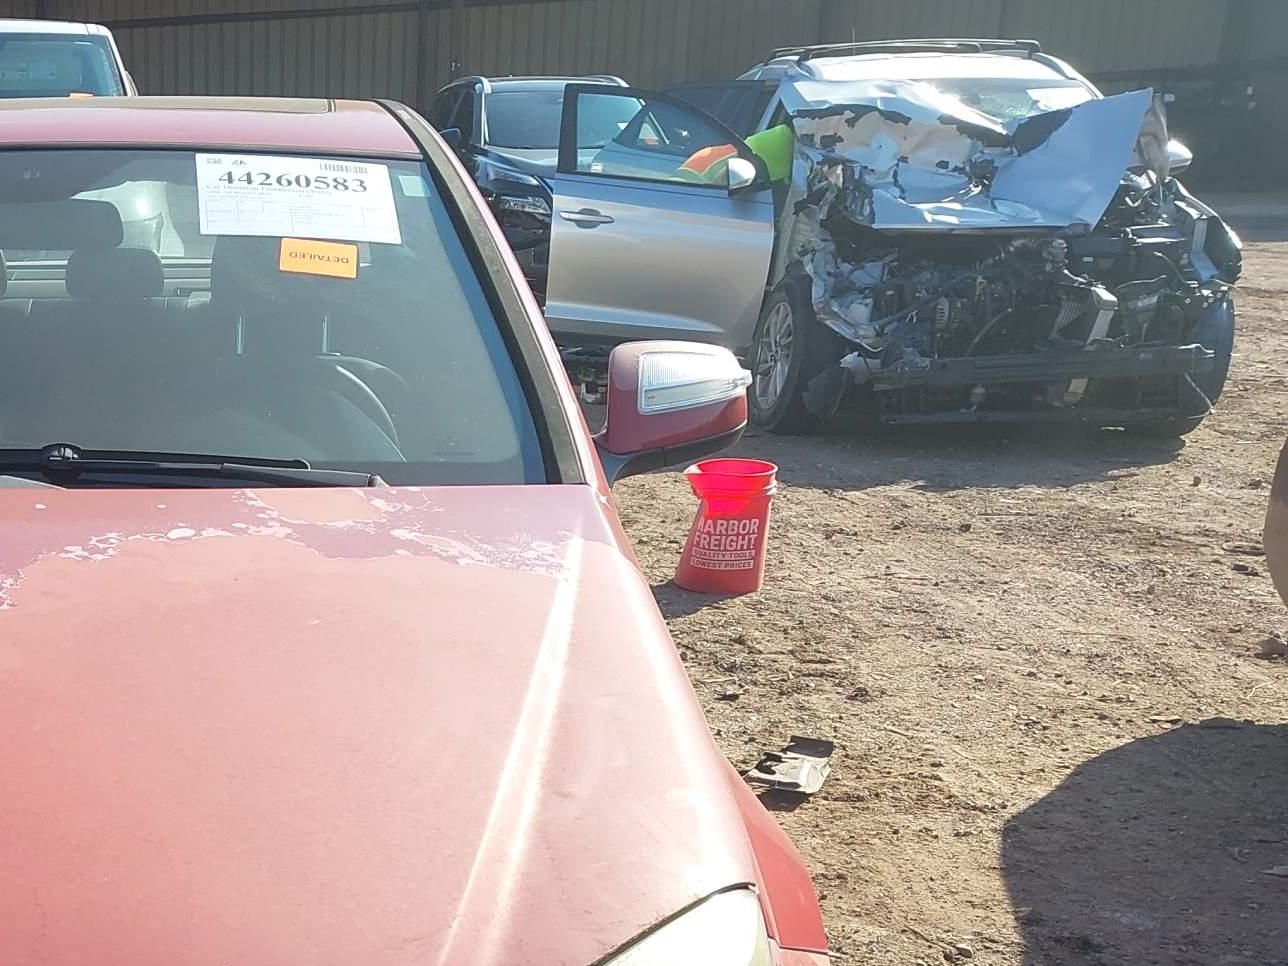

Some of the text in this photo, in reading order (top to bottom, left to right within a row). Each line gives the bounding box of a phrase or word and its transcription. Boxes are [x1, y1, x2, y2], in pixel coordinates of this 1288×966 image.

[218, 170, 368, 193] 44260583
[288, 251, 350, 265] DETAILED
[693, 532, 759, 550] FREIGHT
[693, 548, 753, 559] QUALITY TOOLS
[692, 558, 752, 569] LOWEST PRICES
